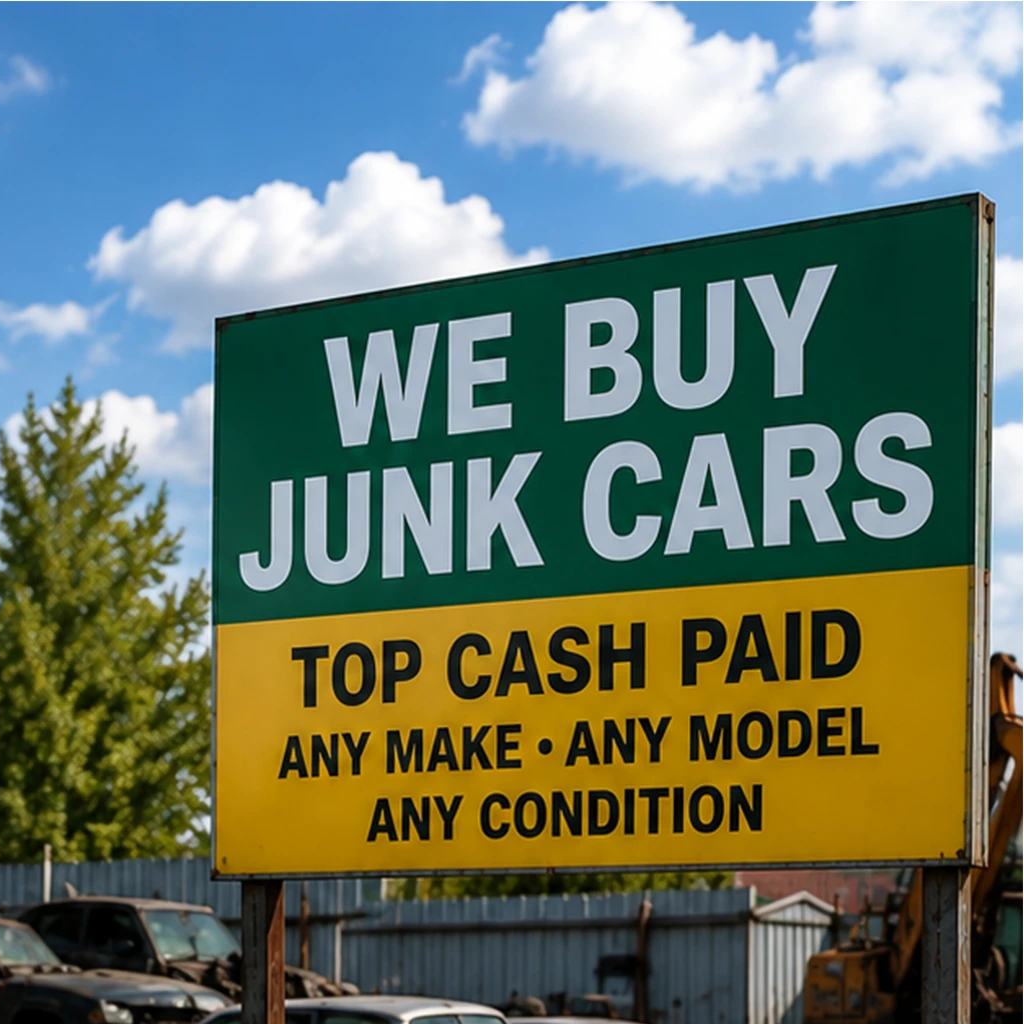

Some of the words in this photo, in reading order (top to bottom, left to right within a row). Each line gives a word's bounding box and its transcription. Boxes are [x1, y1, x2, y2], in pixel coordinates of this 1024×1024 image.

[323, 311, 513, 448] WE
[563, 264, 838, 422] BUY
[238, 451, 545, 593] JUNK
[582, 411, 935, 562] CARS
[291, 639, 422, 708] TOP
[447, 622, 647, 700] CASH
[681, 609, 862, 687] PAID
[278, 731, 371, 780] ANY
[386, 723, 522, 774] MAKE
[564, 716, 672, 767] ANY
[689, 706, 880, 762] MODEL
[366, 795, 464, 843] ANY
[480, 783, 763, 840] CONDITION
